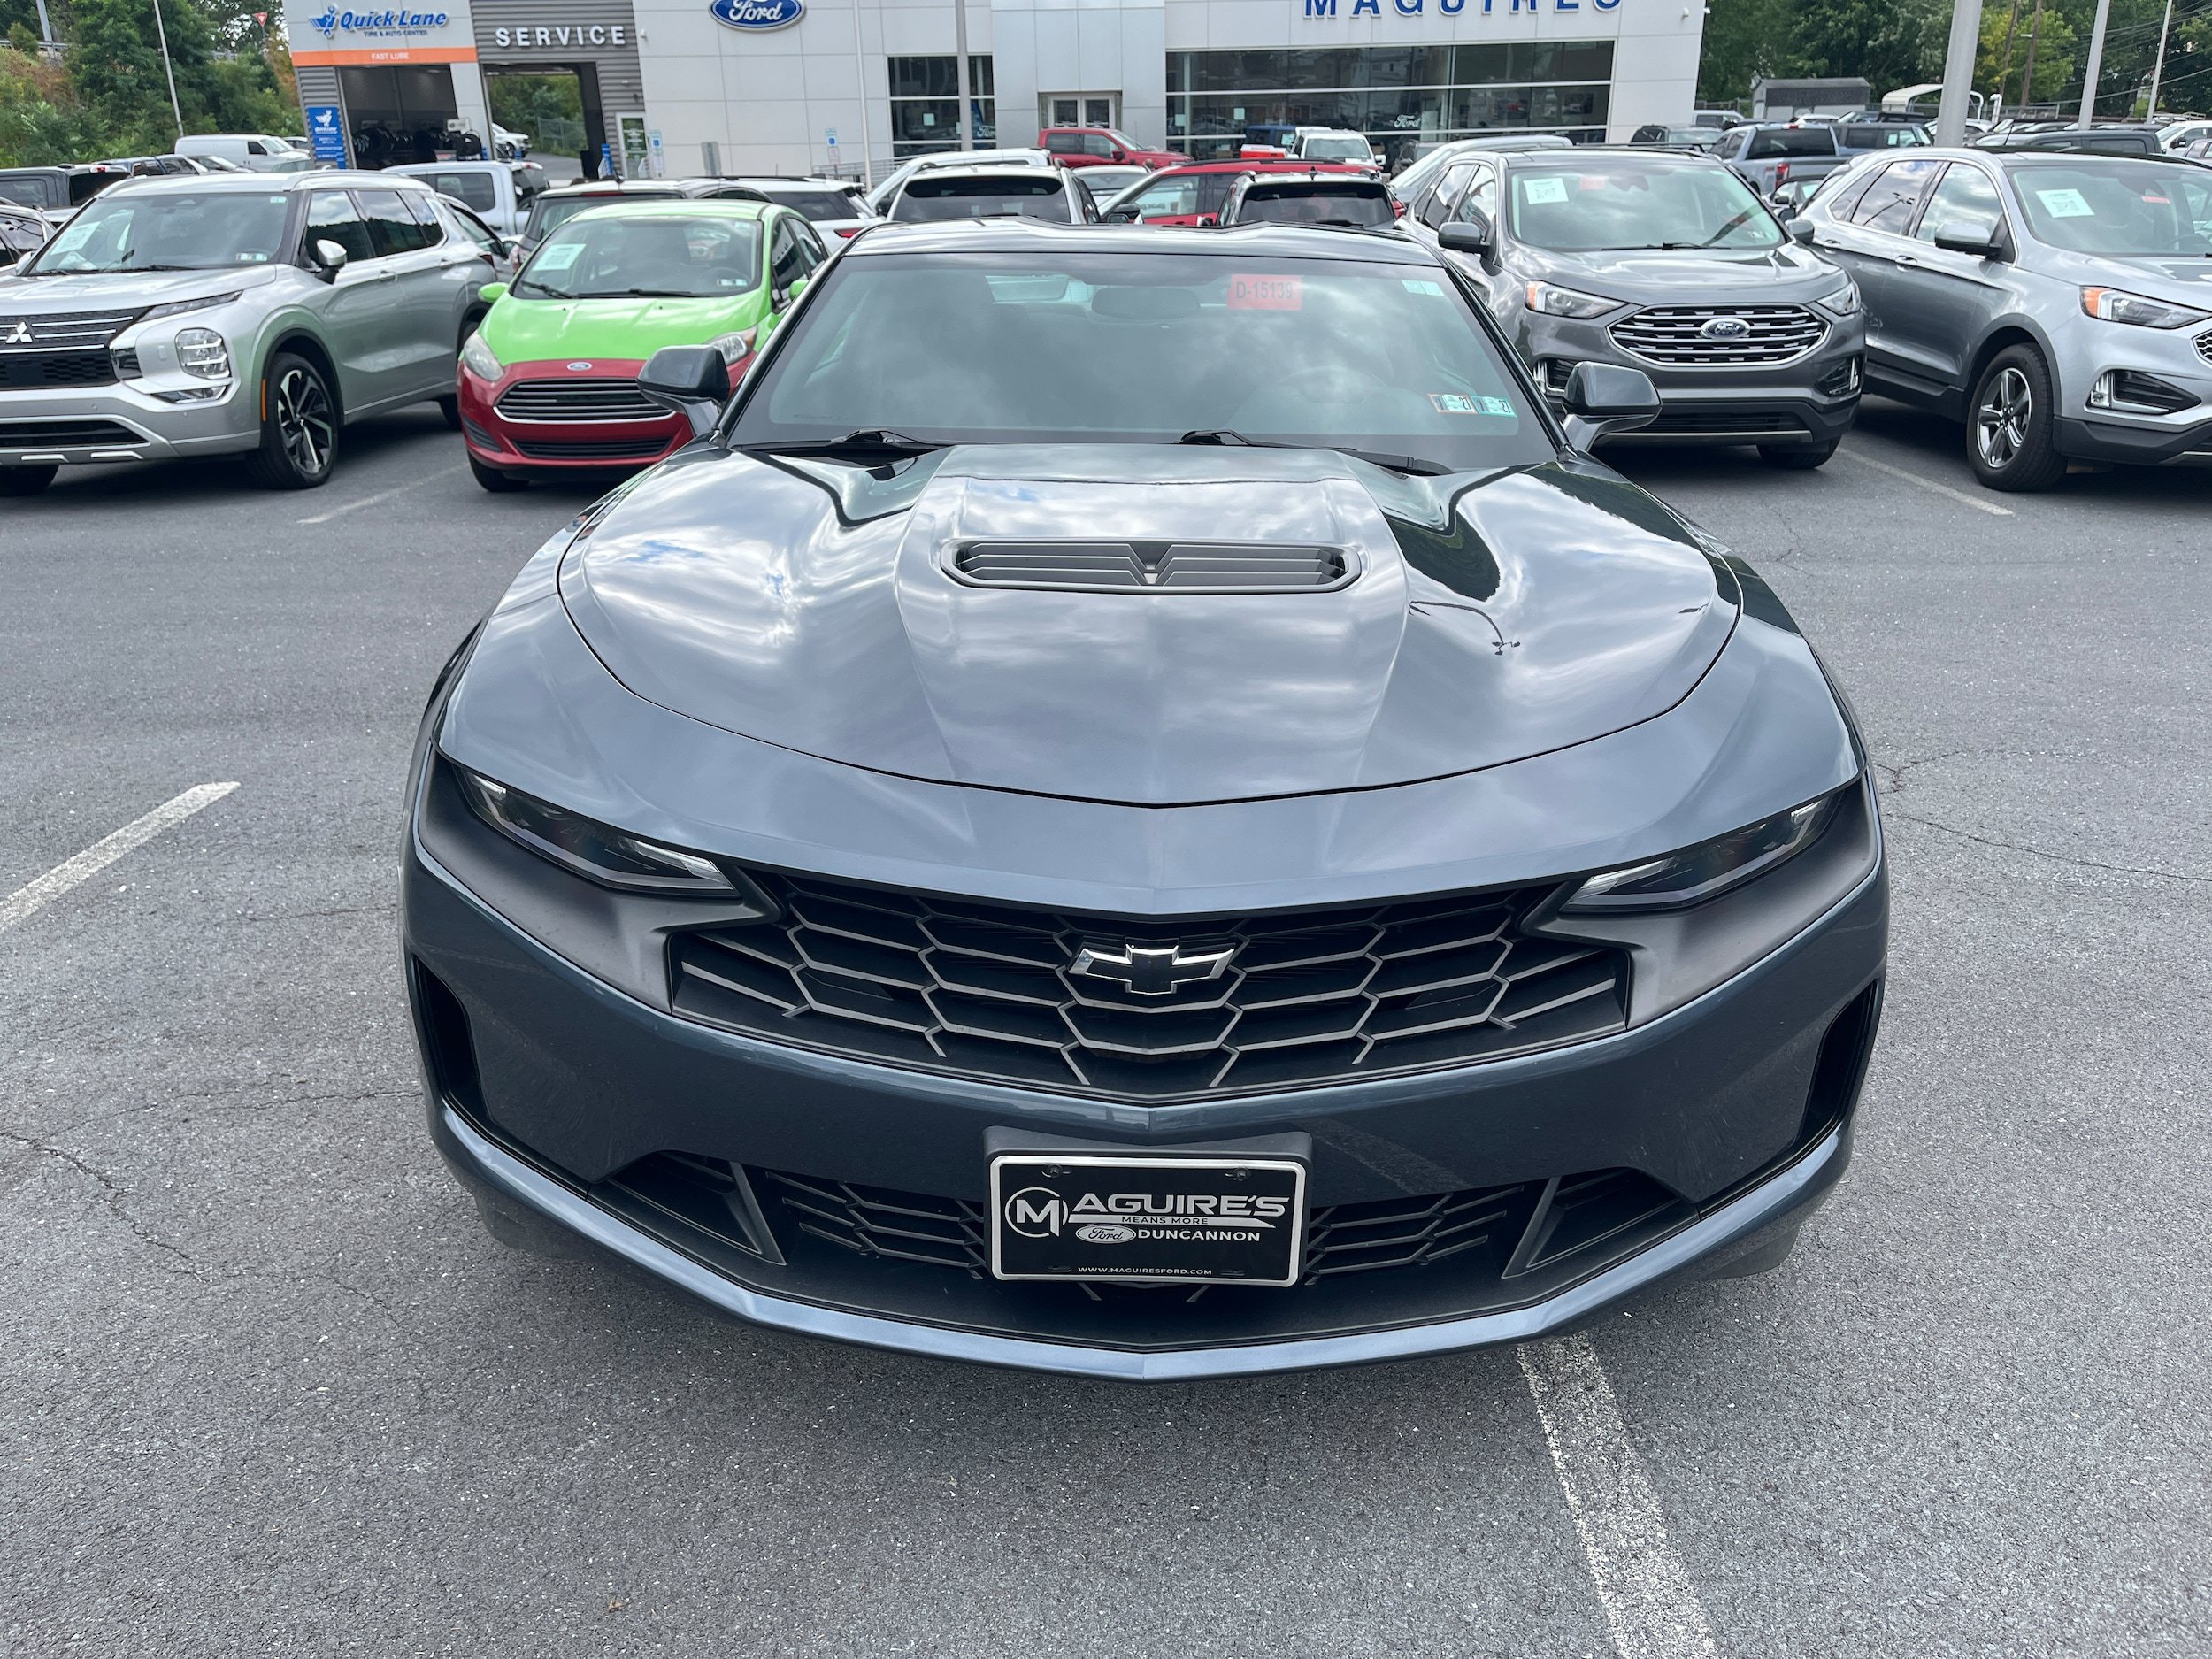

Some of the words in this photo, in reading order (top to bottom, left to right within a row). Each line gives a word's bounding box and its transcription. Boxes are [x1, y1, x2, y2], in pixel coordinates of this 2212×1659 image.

[728, 0, 783, 21] Ford
[341, 11, 396, 30] Quick
[398, 10, 447, 27] Lane
[495, 25, 626, 47] SERVICE
[1394, 114, 1421, 128] Ford
[976, 125, 995, 137] Fo
[1235, 281, 1294, 299] D-15139
[1121, 1216, 1166, 1225] MEANS
[1088, 1227, 1123, 1240] Ford
[1138, 1229, 1261, 1242] DUNCANNON
[1078, 1266, 1212, 1275] WWW.MAGUIRESFORD.COM
